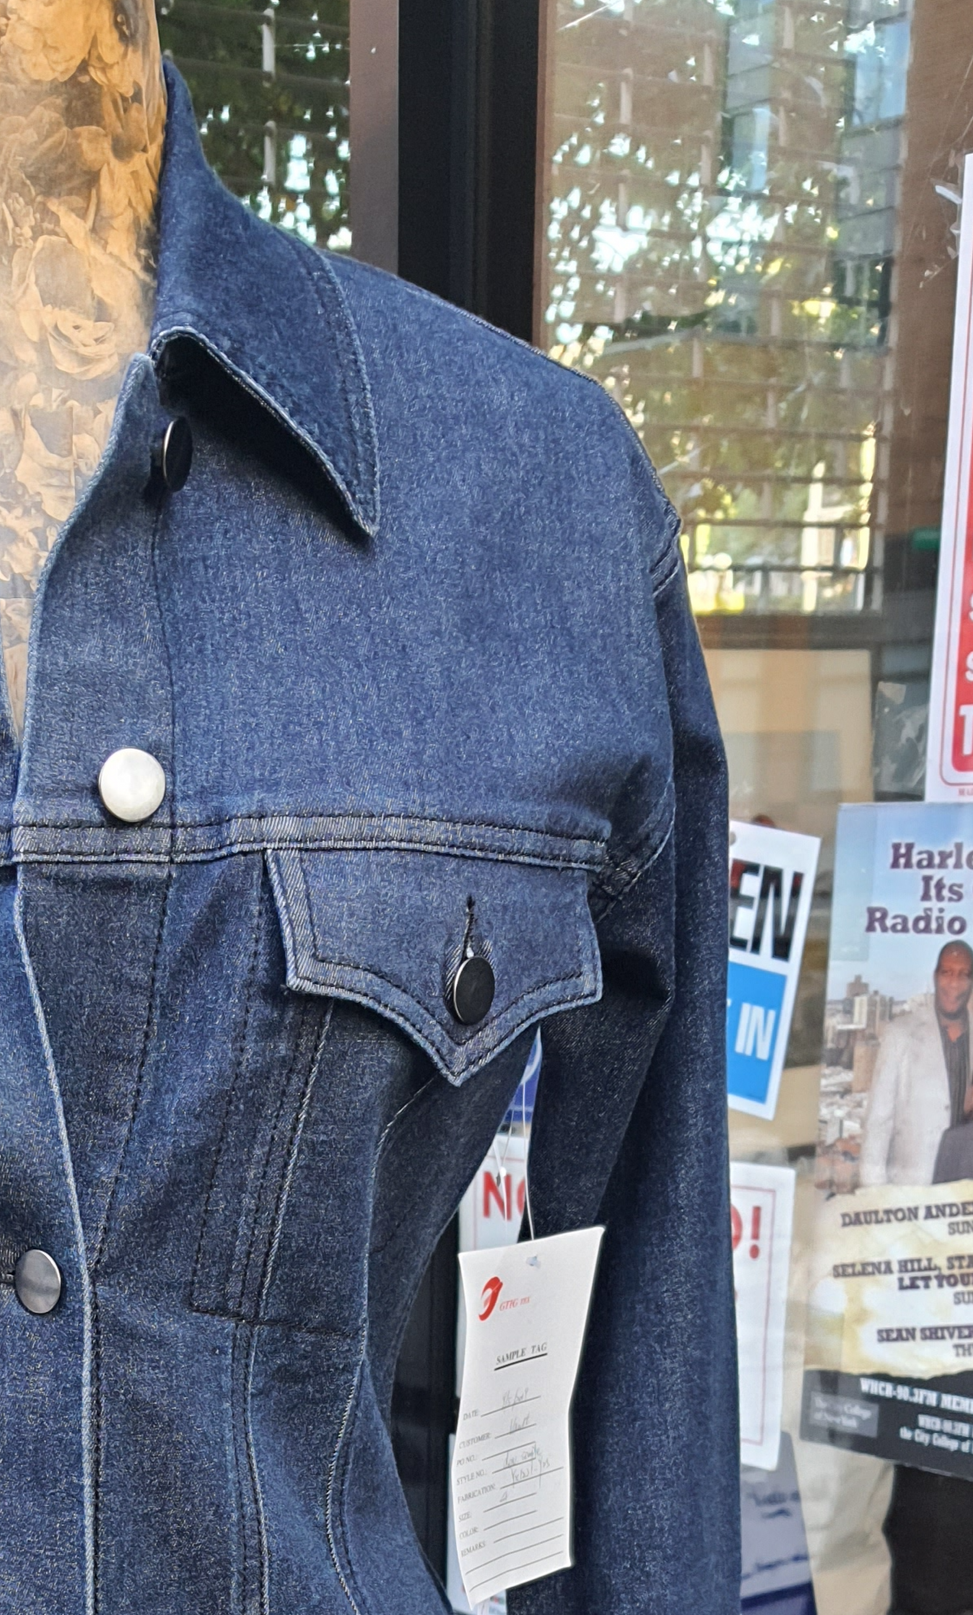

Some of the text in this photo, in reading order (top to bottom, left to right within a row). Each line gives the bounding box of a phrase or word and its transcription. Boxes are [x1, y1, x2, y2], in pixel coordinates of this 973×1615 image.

[920, 875, 965, 902] Its
[865, 906, 968, 935] Radio
[735, 1002, 776, 1061] IN
[841, 1206, 919, 1228] DAULTON
[833, 1260, 894, 1279] SELENA
[898, 1275, 932, 1291] LET
[953, 1290, 973, 1306] SU
[877, 1327, 916, 1343] SEAN
[495, 1341, 548, 1366] SAMPLE TAG
[932, 1432, 959, 1453] College
[456, 1472, 475, 1486] STYLE
